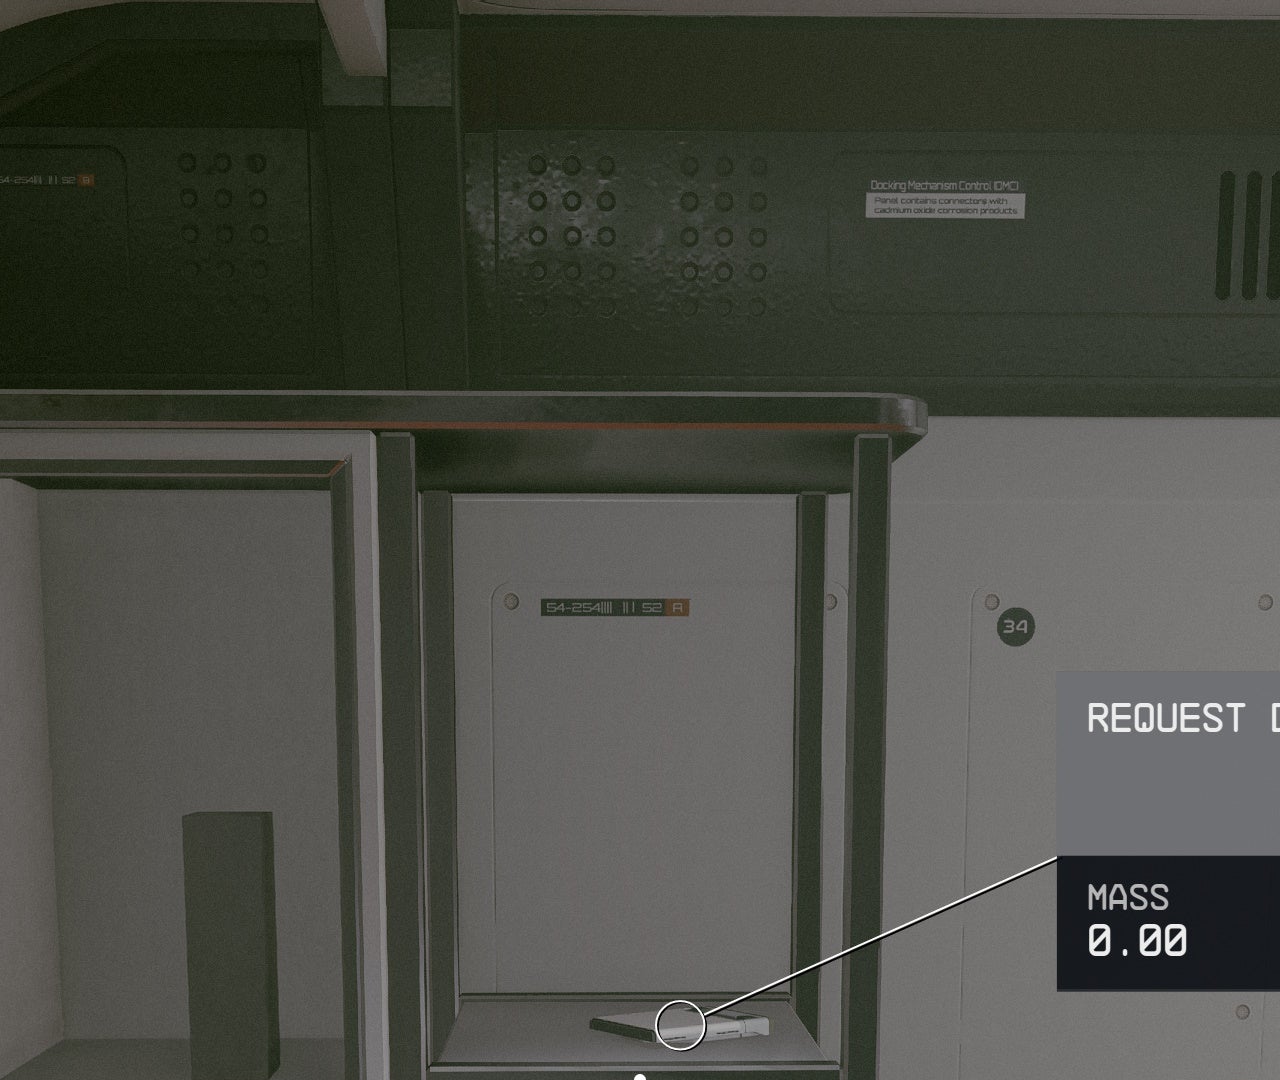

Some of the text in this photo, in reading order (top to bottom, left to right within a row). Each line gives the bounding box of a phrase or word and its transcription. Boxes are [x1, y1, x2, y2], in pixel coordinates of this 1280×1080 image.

[870, 180, 906, 192] Docking
[908, 180, 957, 191] Mechanism
[959, 181, 991, 191] Control
[874, 196, 1008, 206] Panel contains connectors with
[913, 206, 936, 215] oxide
[937, 207, 978, 215] corrosion
[980, 207, 1018, 216] products
[1003, 619, 1028, 634] 34
